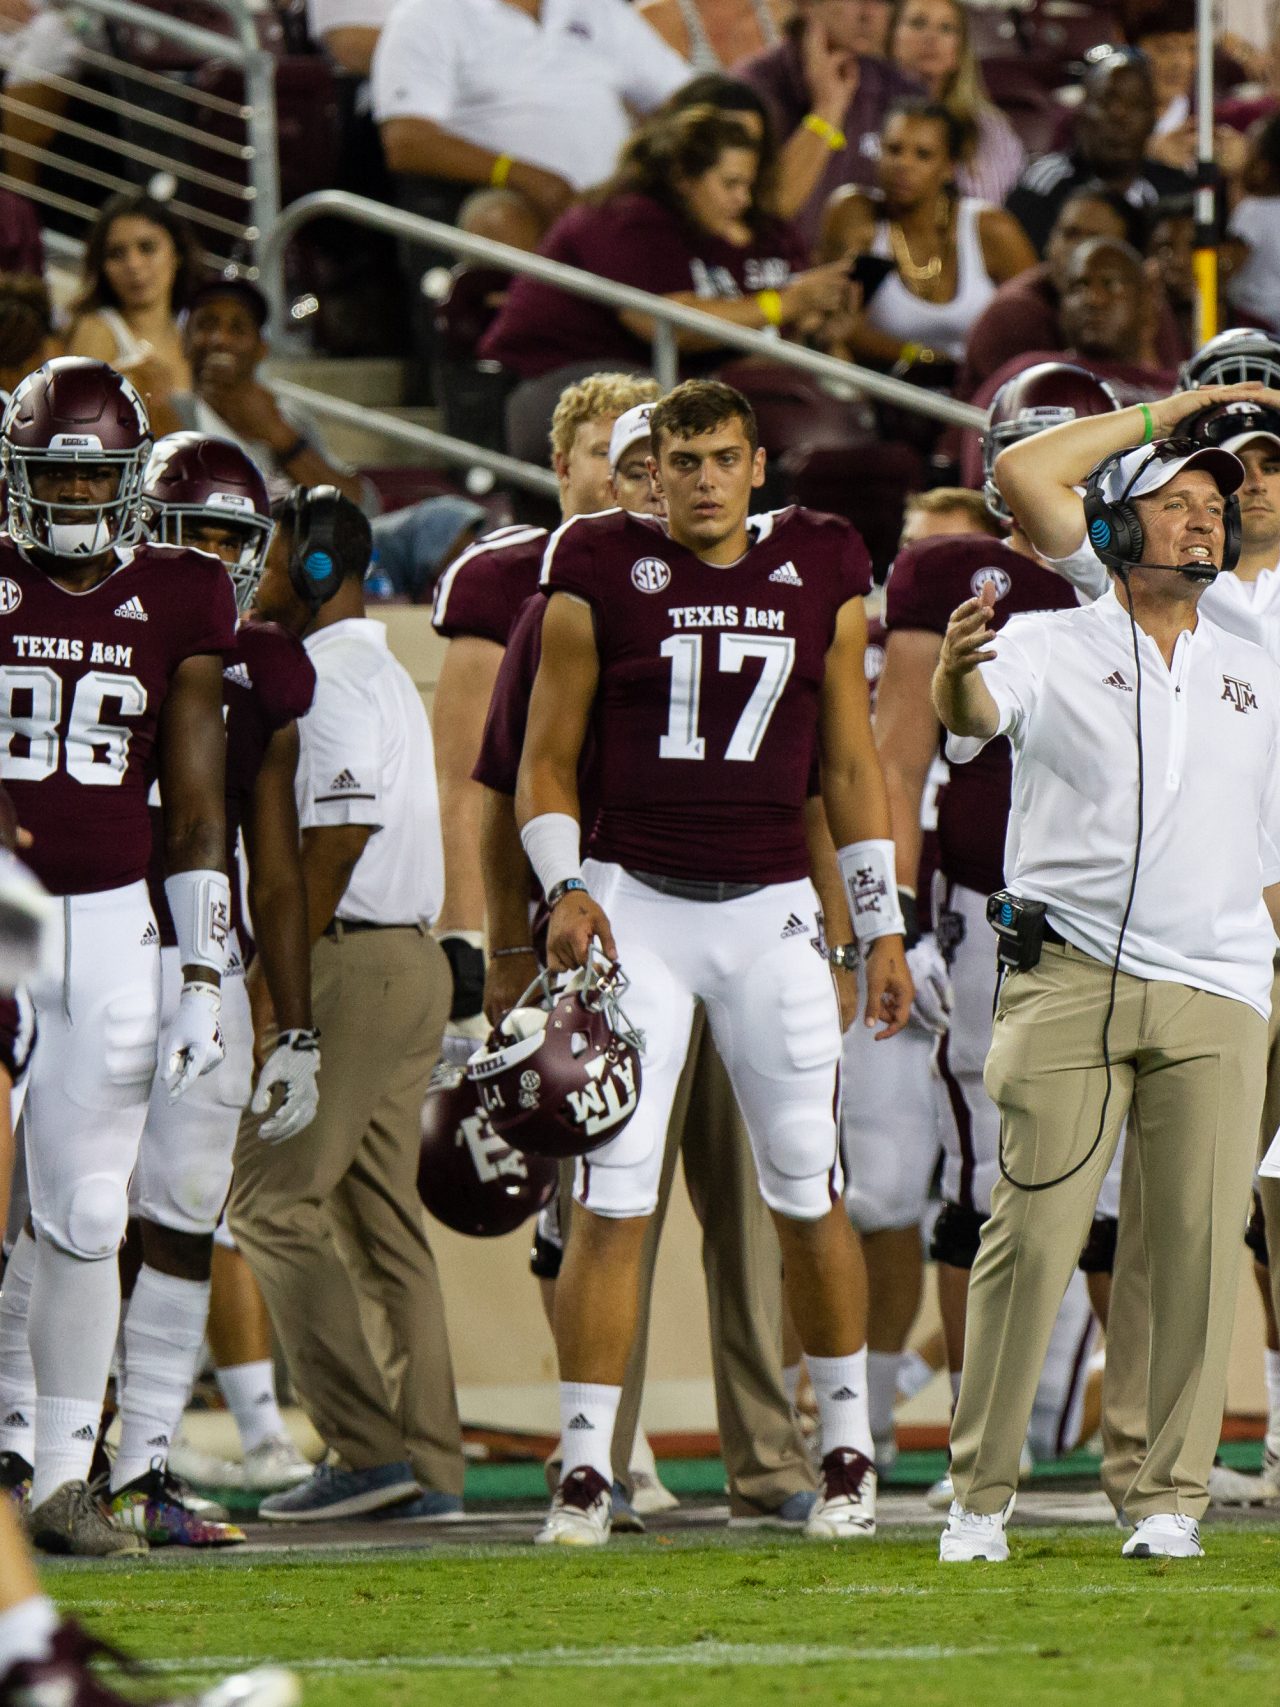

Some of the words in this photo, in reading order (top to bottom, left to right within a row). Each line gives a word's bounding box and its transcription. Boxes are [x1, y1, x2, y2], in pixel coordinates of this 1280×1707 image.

[114, 608, 148, 622] adidas
[668, 605, 739, 629] TEXAS
[744, 606, 786, 631] A&M
[13, 634, 84, 662] TEXAS
[90, 642, 133, 668] A&M
[659, 632, 796, 762] 17
[0, 665, 148, 787] 86
